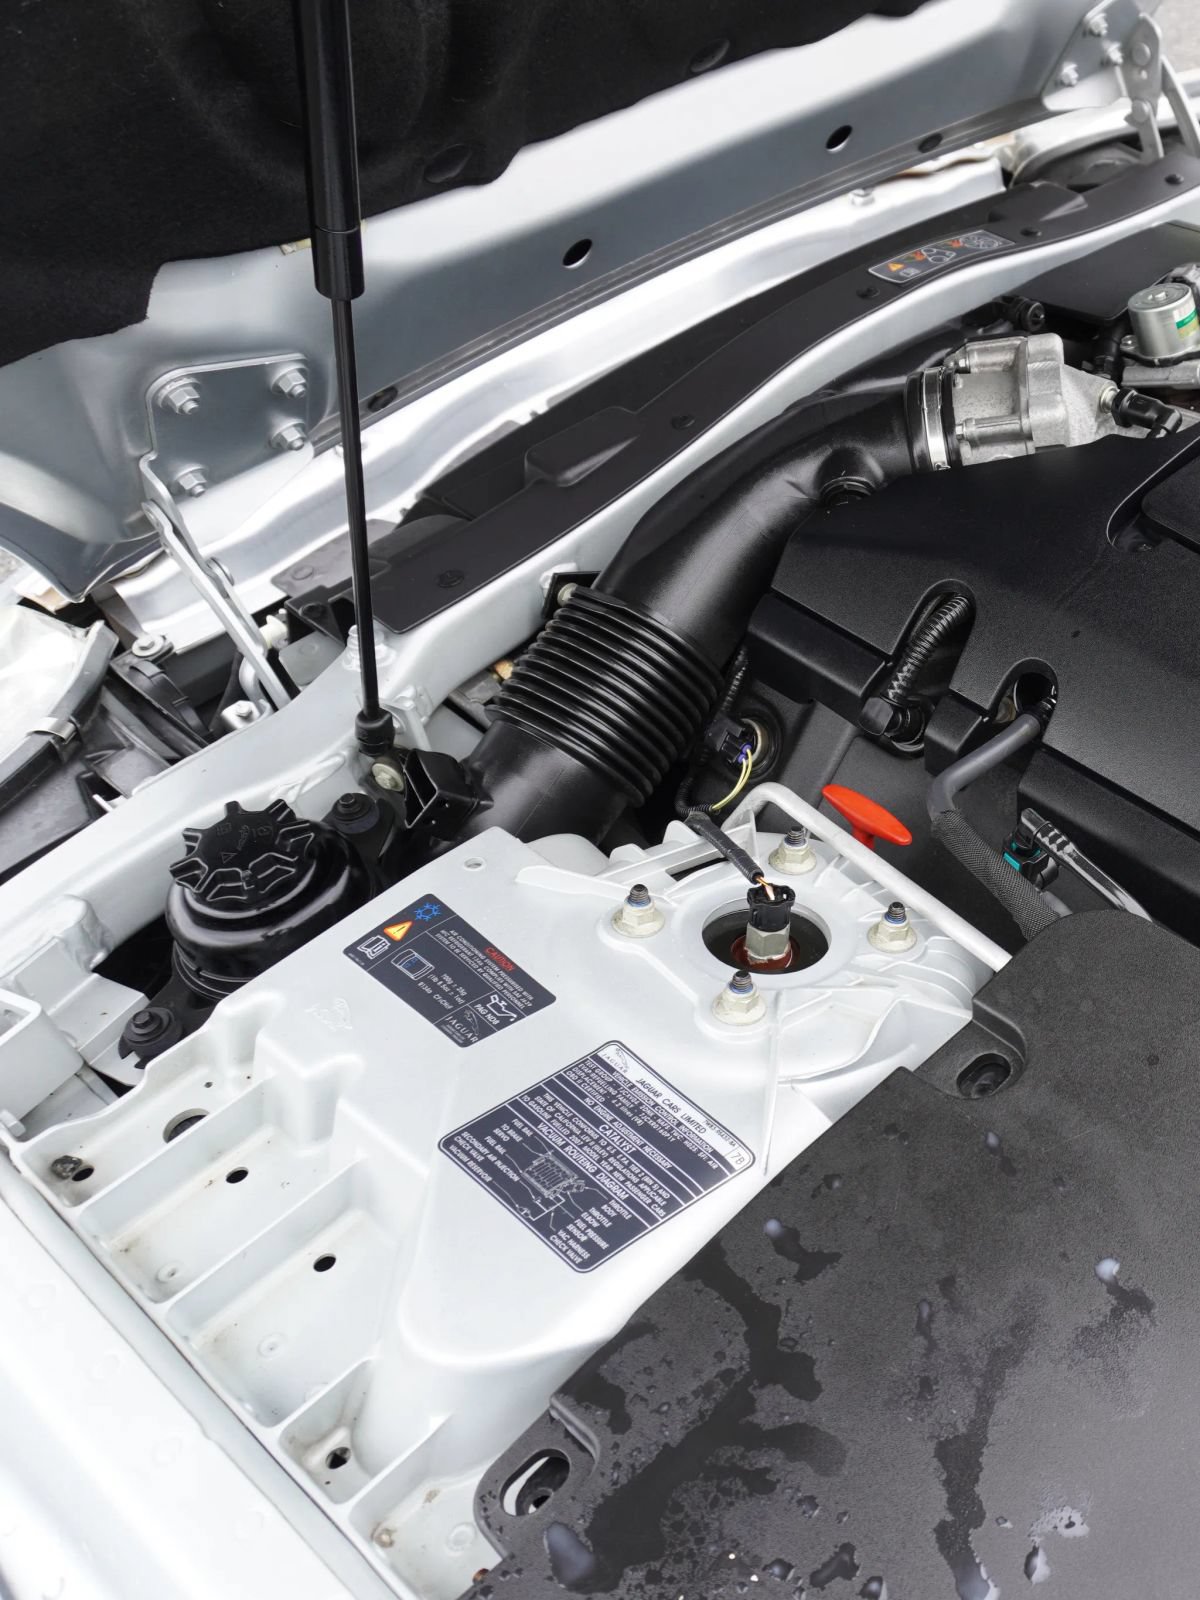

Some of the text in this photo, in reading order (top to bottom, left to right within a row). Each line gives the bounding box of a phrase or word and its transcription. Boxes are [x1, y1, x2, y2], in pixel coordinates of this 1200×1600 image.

[484, 946, 515, 972] CAUTION
[457, 951, 480, 969] SERVICED
[475, 966, 485, 974] BY
[480, 971, 505, 991] QUALIFIED
[500, 988, 526, 1009] PERSONNEL
[472, 1002, 490, 1015] PAG
[444, 1015, 480, 1043] JAGUAR
[601, 1052, 628, 1074] JAGUAR
[564, 1069, 580, 1081] OBD
[578, 1081, 606, 1104] CERTIFIED
[570, 1065, 608, 1096] DISPLACEMENT
[583, 1058, 597, 1070] TEST
[593, 1067, 614, 1083] GROUP
[705, 1158, 720, 1170] AIR
[610, 1069, 714, 1154] VEHICLE EMISSION CONTROL INFORMATION
[614, 1093, 635, 1109] FAMILY
[634, 1076, 708, 1135] JAGUAR CARS LIMITED
[491, 1126, 511, 1142] SERVO
[499, 1122, 524, 1143] TO BRAKE
[510, 1117, 535, 1137] FUEL RAIL
[582, 1096, 673, 1170] NO ENGINE ADJUSTMENT NECESSARY
[596, 1122, 637, 1155] CATALYST
[451, 1134, 486, 1162] CHECK VALVE
[459, 1130, 521, 1182] SECONDARY AIR INJECTION
[482, 1134, 508, 1155] FUEL RAIL
[520, 1094, 532, 1103] TO
[526, 1099, 552, 1120] GASOLINE
[548, 1117, 571, 1136] FUELLED
[580, 1144, 602, 1161] MODEL
[597, 1158, 615, 1172] YEAR
[610, 1169, 626, 1182] NEW
[623, 1179, 653, 1205] PASSENGER
[648, 1202, 668, 1217] CARS
[532, 1094, 549, 1108] STATE
[544, 1104, 556, 1113] OF
[552, 1110, 583, 1136] CALIFORNIA
[579, 1133, 592, 1143] LEV
[606, 1155, 641, 1184] REGULATIONS
[636, 1181, 668, 1207] APPLICABLE
[541, 1091, 555, 1103] THIS
[551, 1100, 574, 1118] VEHICLE
[570, 1115, 601, 1140] CONFORMS
[596, 1137, 609, 1147] TO
[627, 1162, 642, 1174] TIER
[655, 1187, 672, 1200] AND
[728, 1151, 748, 1166] 7B
[446, 1143, 493, 1183] VACUUM RESERVOIR
[535, 1121, 630, 1201] VACUUM ROUTEING DIAGRAM
[579, 1210, 601, 1229] ELBOW
[586, 1206, 613, 1228] THROTTLE
[599, 1203, 618, 1218] BODY
[606, 1198, 633, 1221] THROTTLE
[555, 1228, 592, 1260] VAC HARNESS
[564, 1222, 589, 1243] SENSOR
[572, 1217, 610, 1250] FUEL PRESSURE
[547, 1233, 584, 1265] CHECK VALVE
